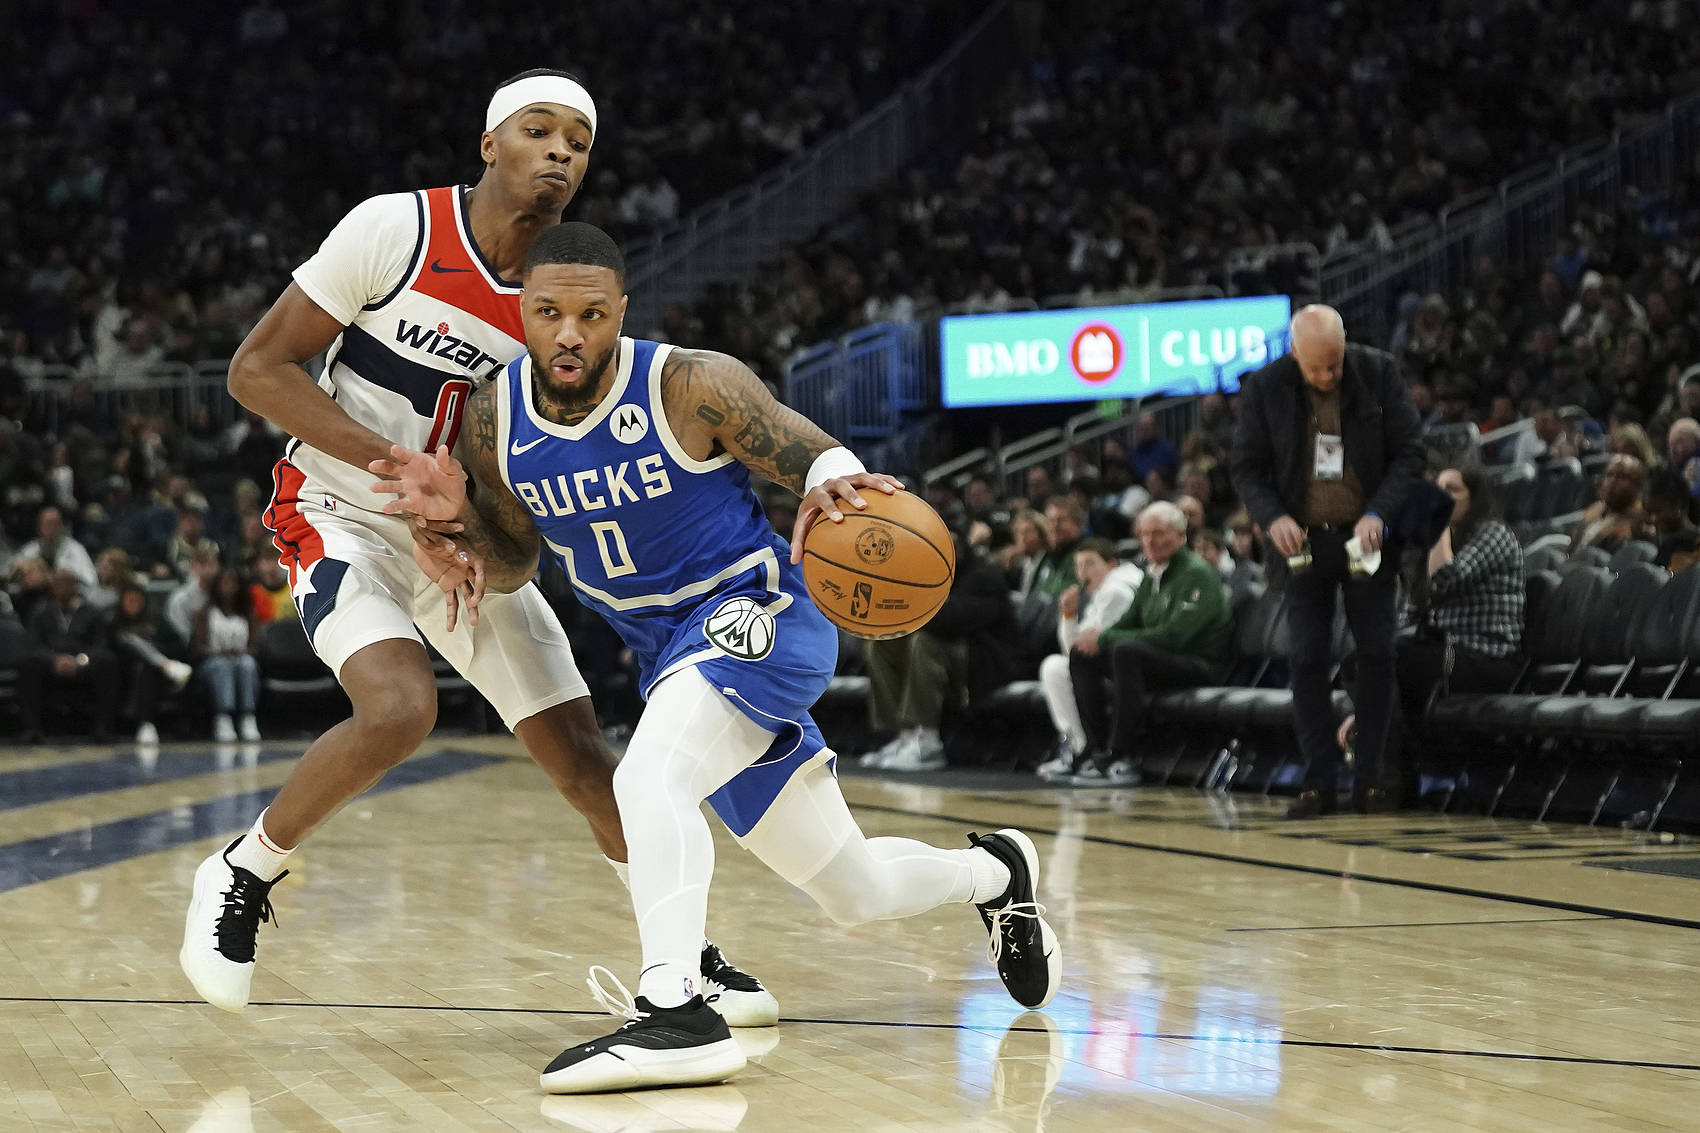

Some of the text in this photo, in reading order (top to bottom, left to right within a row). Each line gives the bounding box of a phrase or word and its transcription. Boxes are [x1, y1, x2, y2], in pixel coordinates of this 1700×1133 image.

[966, 325, 1268, 379] BMO CLUB
[515, 452, 673, 518] BUCKS
[589, 520, 638, 580] 0
